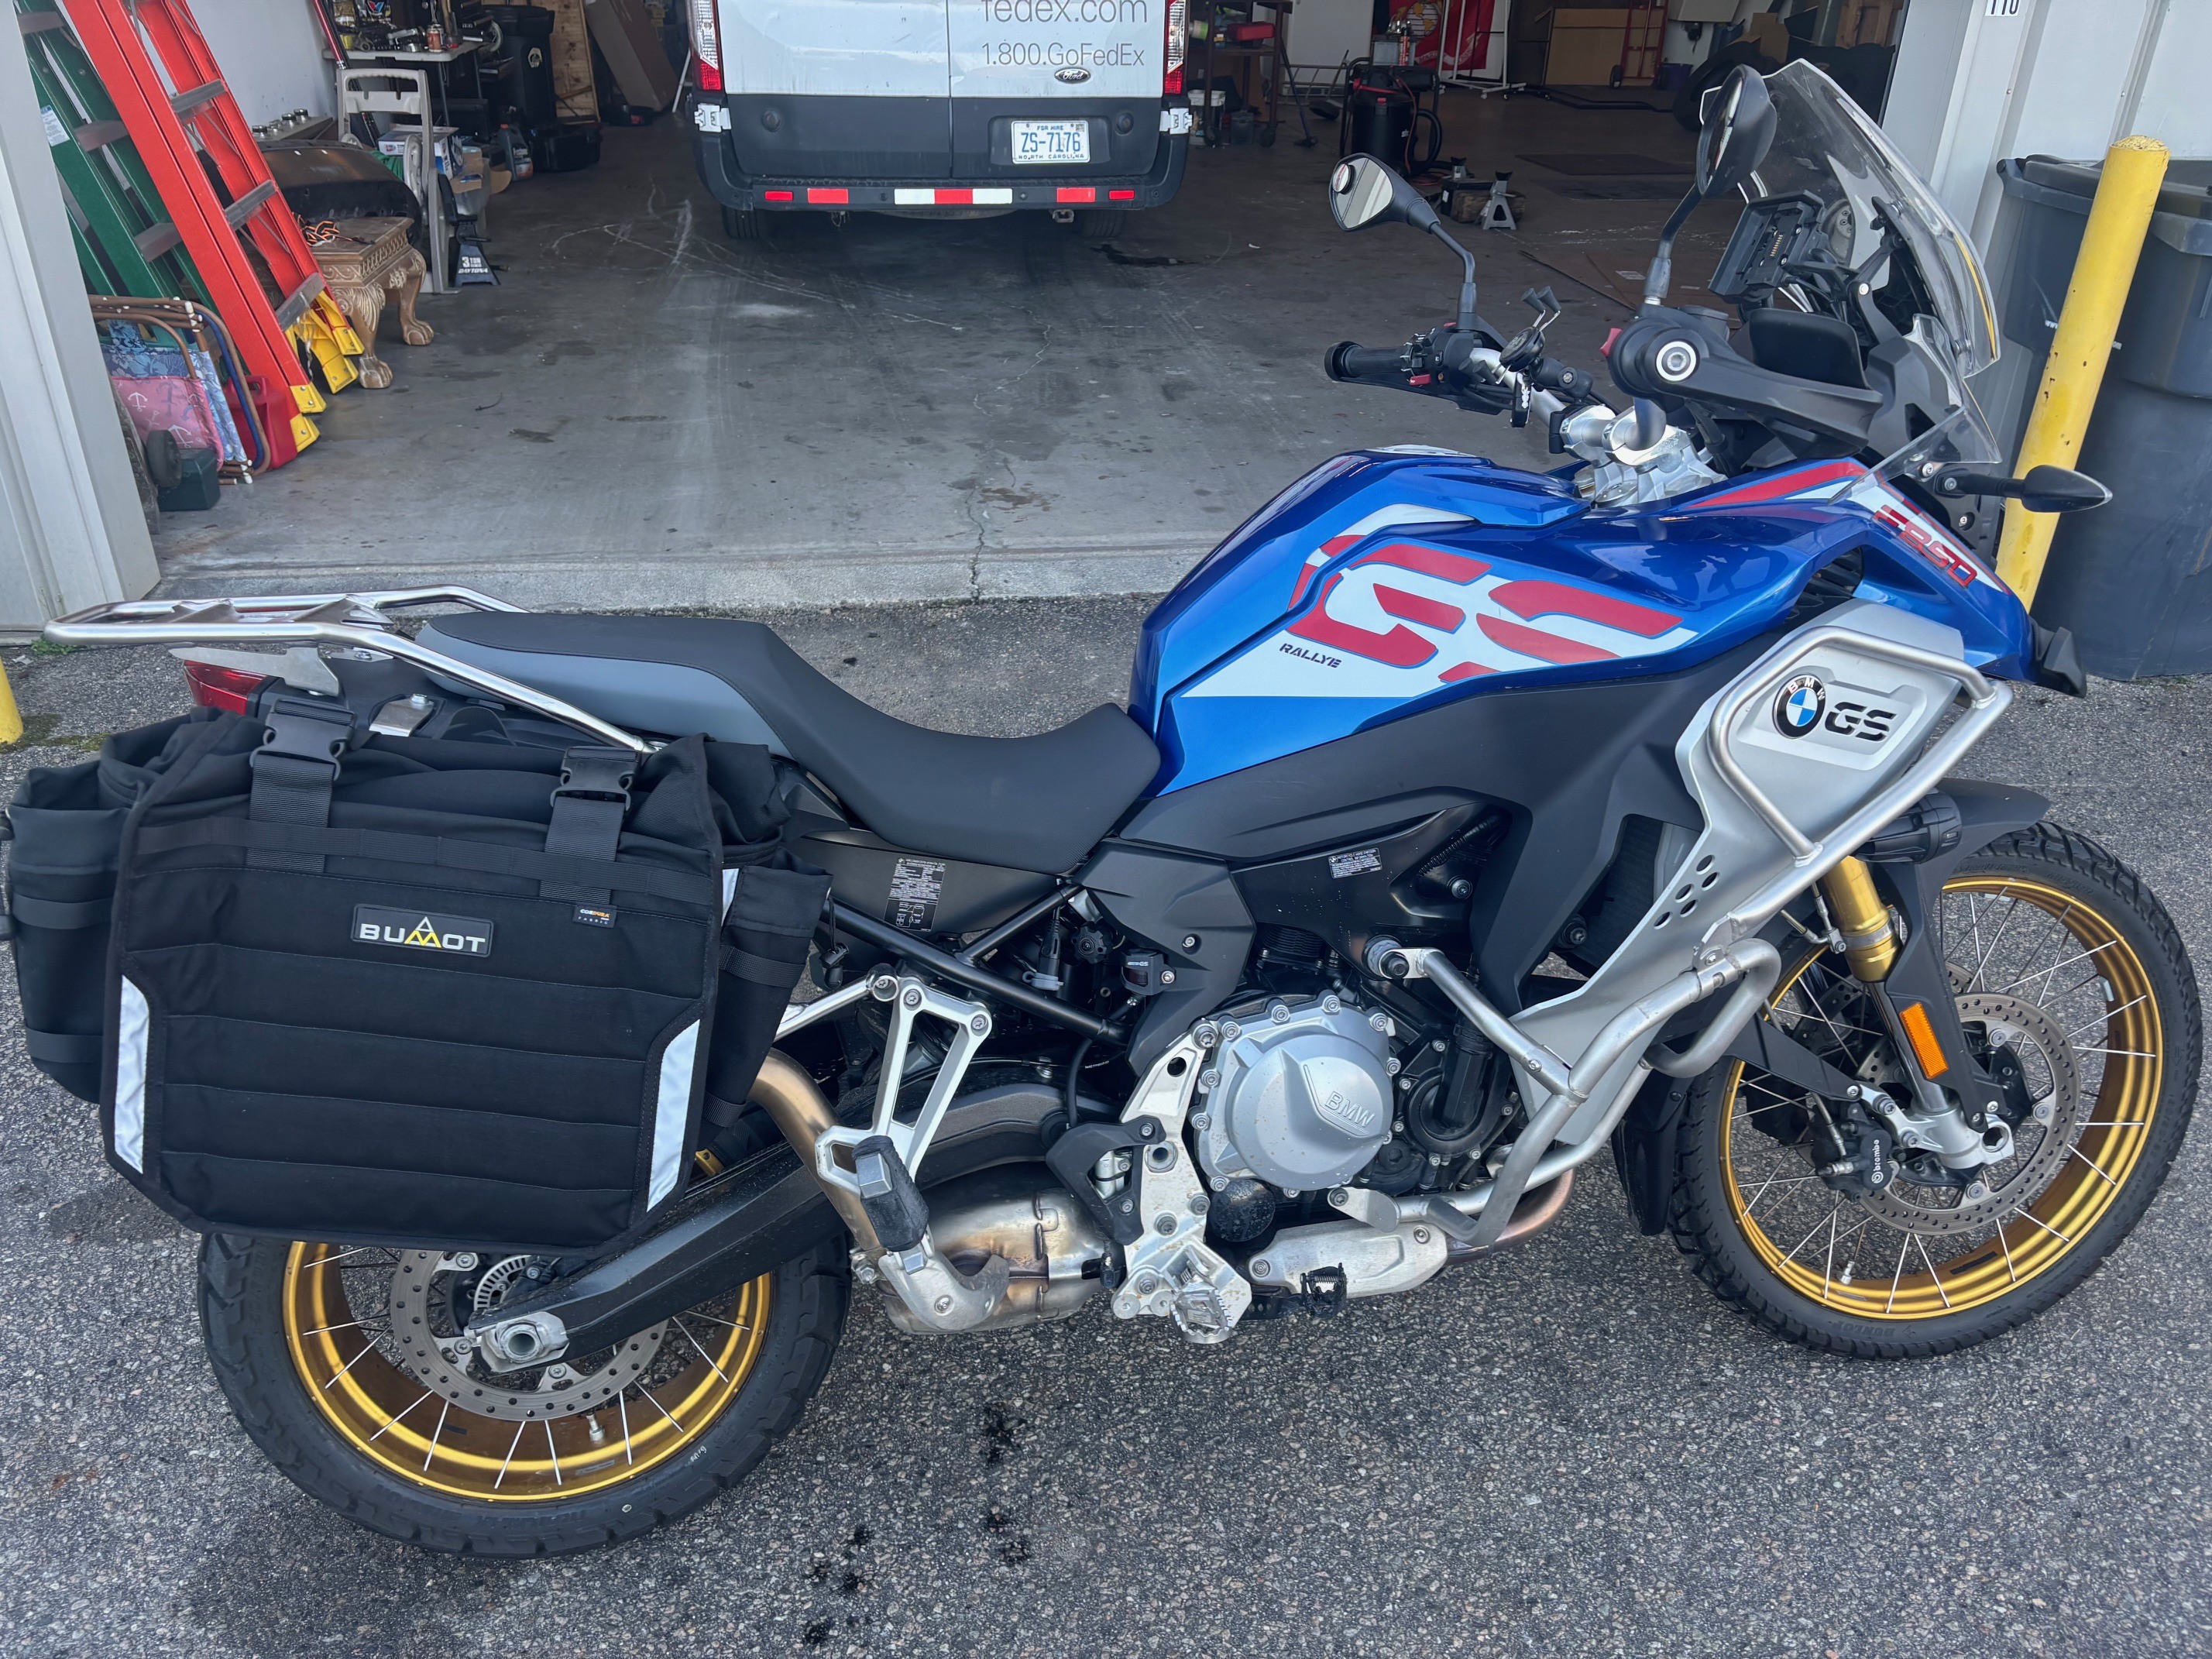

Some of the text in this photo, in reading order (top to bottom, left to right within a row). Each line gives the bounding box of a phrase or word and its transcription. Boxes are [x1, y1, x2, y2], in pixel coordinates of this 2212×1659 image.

[981, 0, 1148, 23] fedex.com
[981, 42, 1145, 67] 1.800.GoFedEx
[1021, 132, 1081, 153] ZS-7176
[462, 256, 471, 268] 3
[1871, 504, 1977, 587] F850
[1279, 643, 1342, 668] RALLYE
[1825, 701, 1897, 741] GS
[359, 917, 486, 952] BUMOT
[1324, 1091, 1376, 1128] BMW
[1872, 1139, 1881, 1171] brembo
